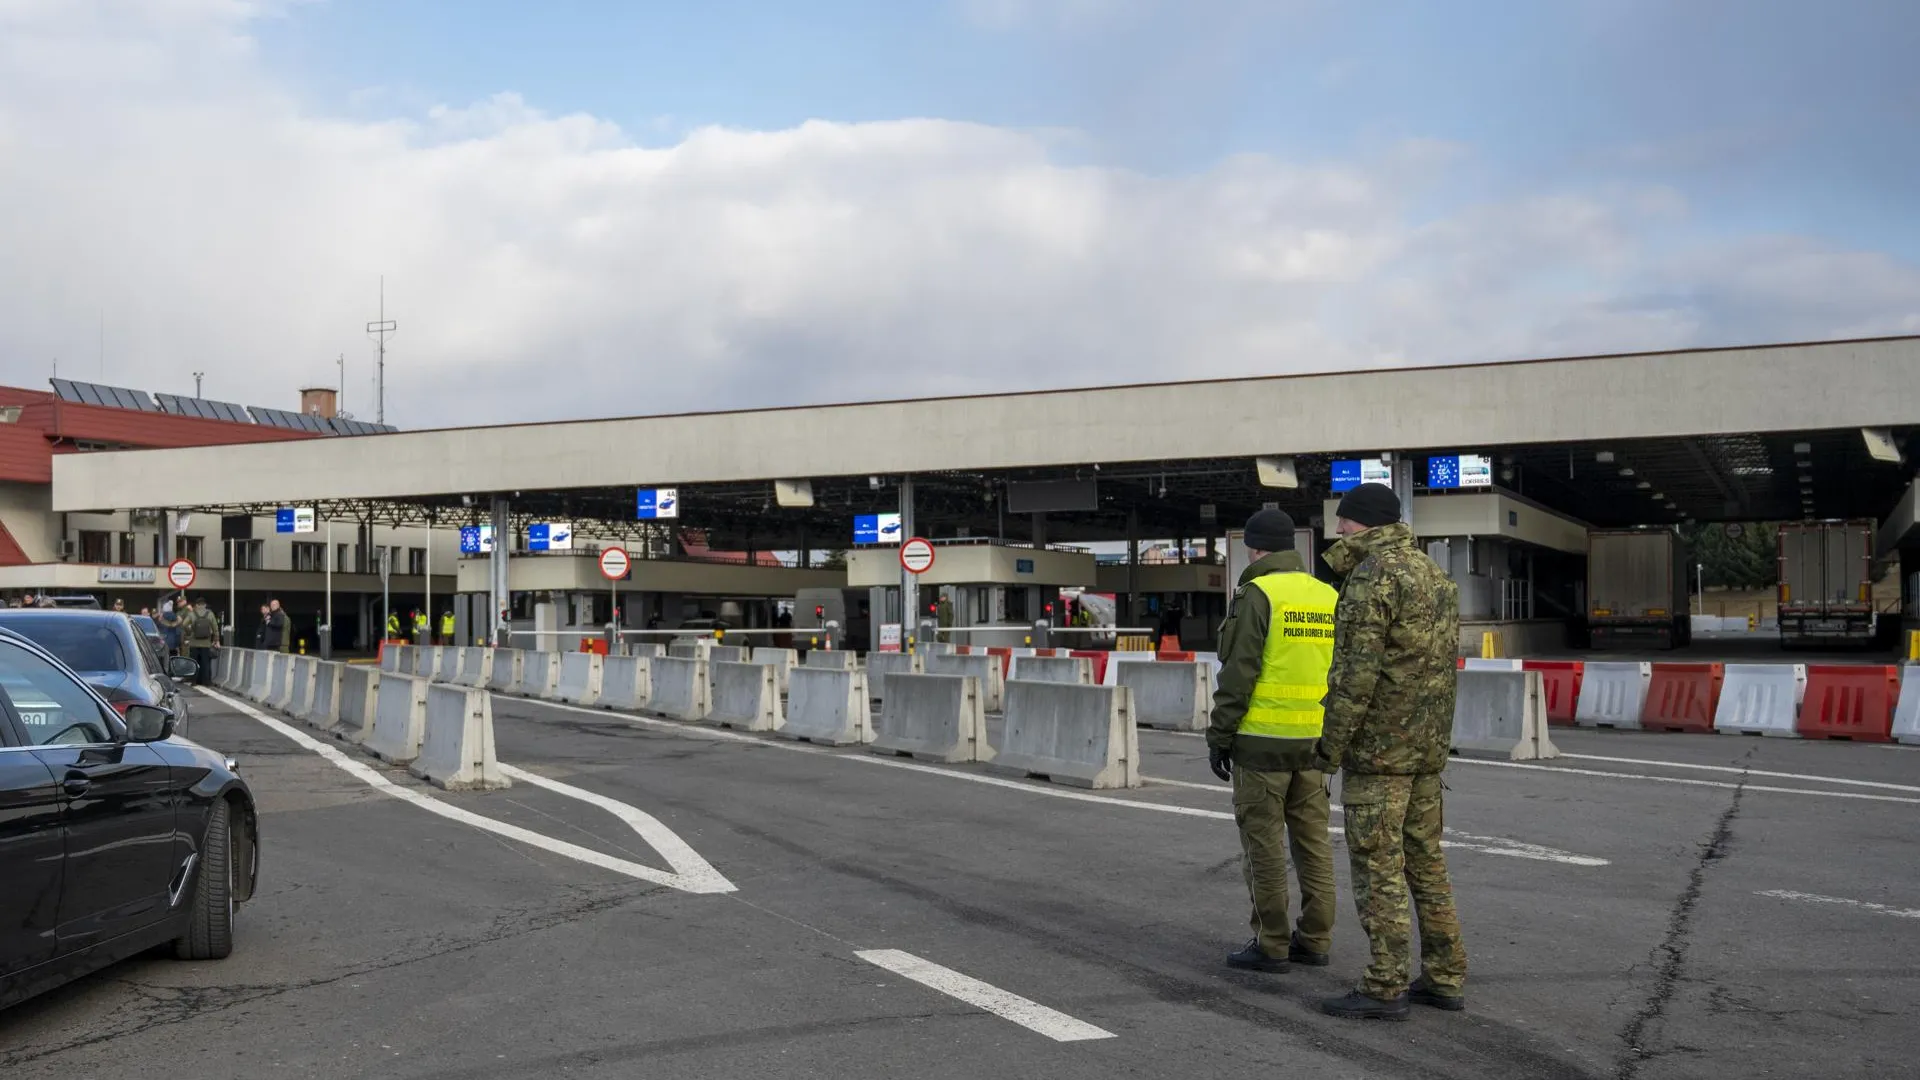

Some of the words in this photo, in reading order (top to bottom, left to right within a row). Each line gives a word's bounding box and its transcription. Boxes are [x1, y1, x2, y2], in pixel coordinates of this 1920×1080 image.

[1284, 611, 1305, 623] STRAŻ
[1284, 628, 1304, 637] POLISH
[1305, 628, 1323, 637] BORDER
